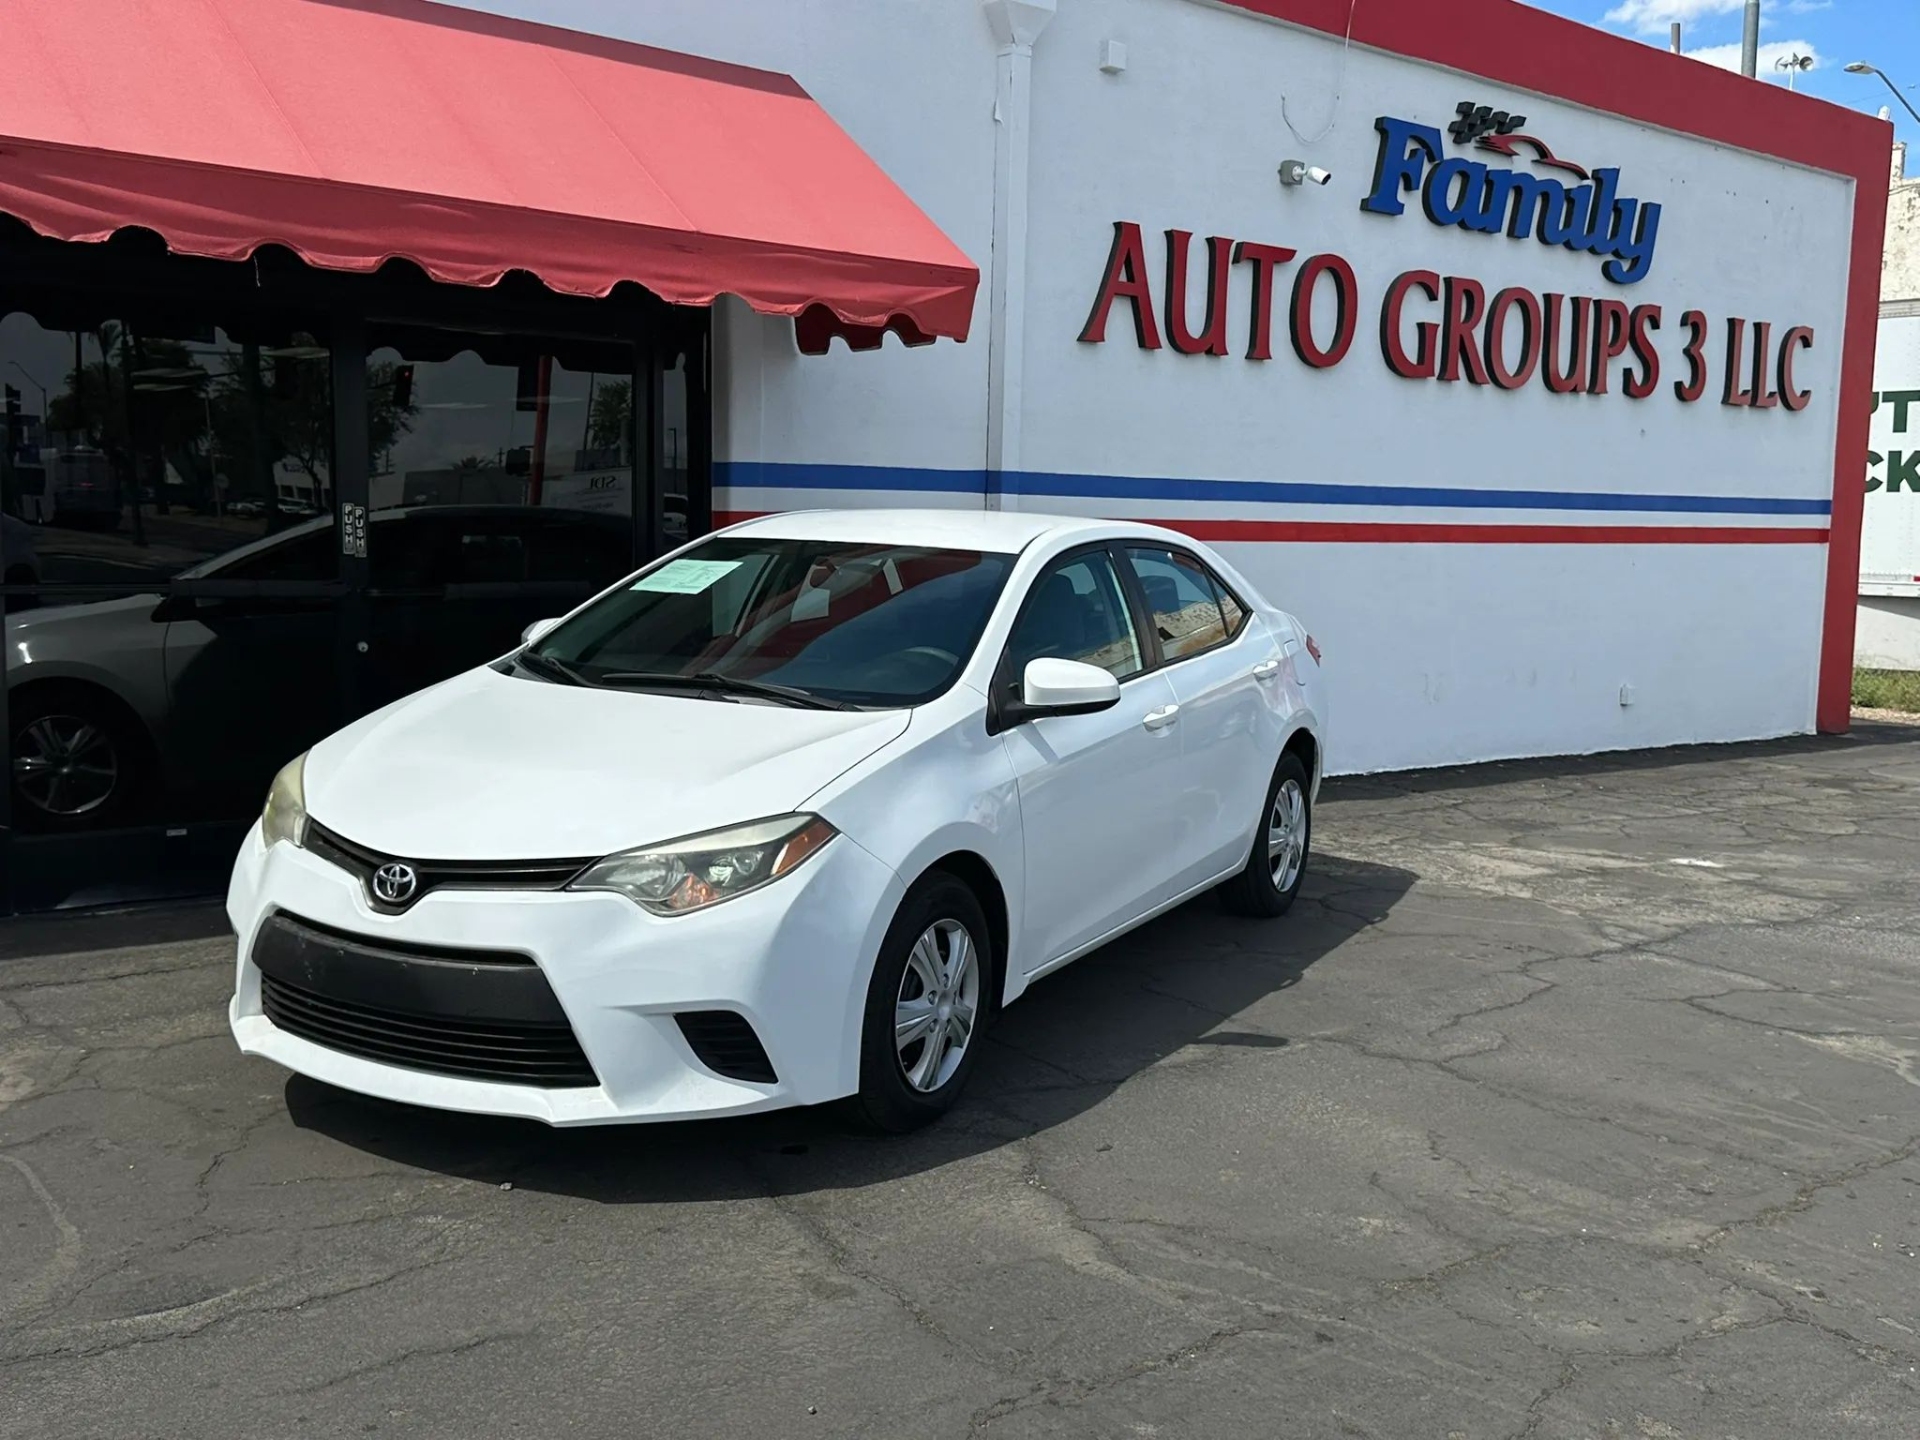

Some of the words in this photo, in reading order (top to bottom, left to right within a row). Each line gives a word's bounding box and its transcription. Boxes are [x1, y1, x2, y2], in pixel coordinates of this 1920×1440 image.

[1360, 116, 1662, 284] Family
[1077, 221, 1358, 368] AUTO
[1380, 270, 1662, 398] GROUPS
[1674, 310, 1707, 401] 3
[1721, 317, 1814, 411] LLC
[344, 505, 353, 543] PUSH
[355, 509, 364, 547] PUSH
